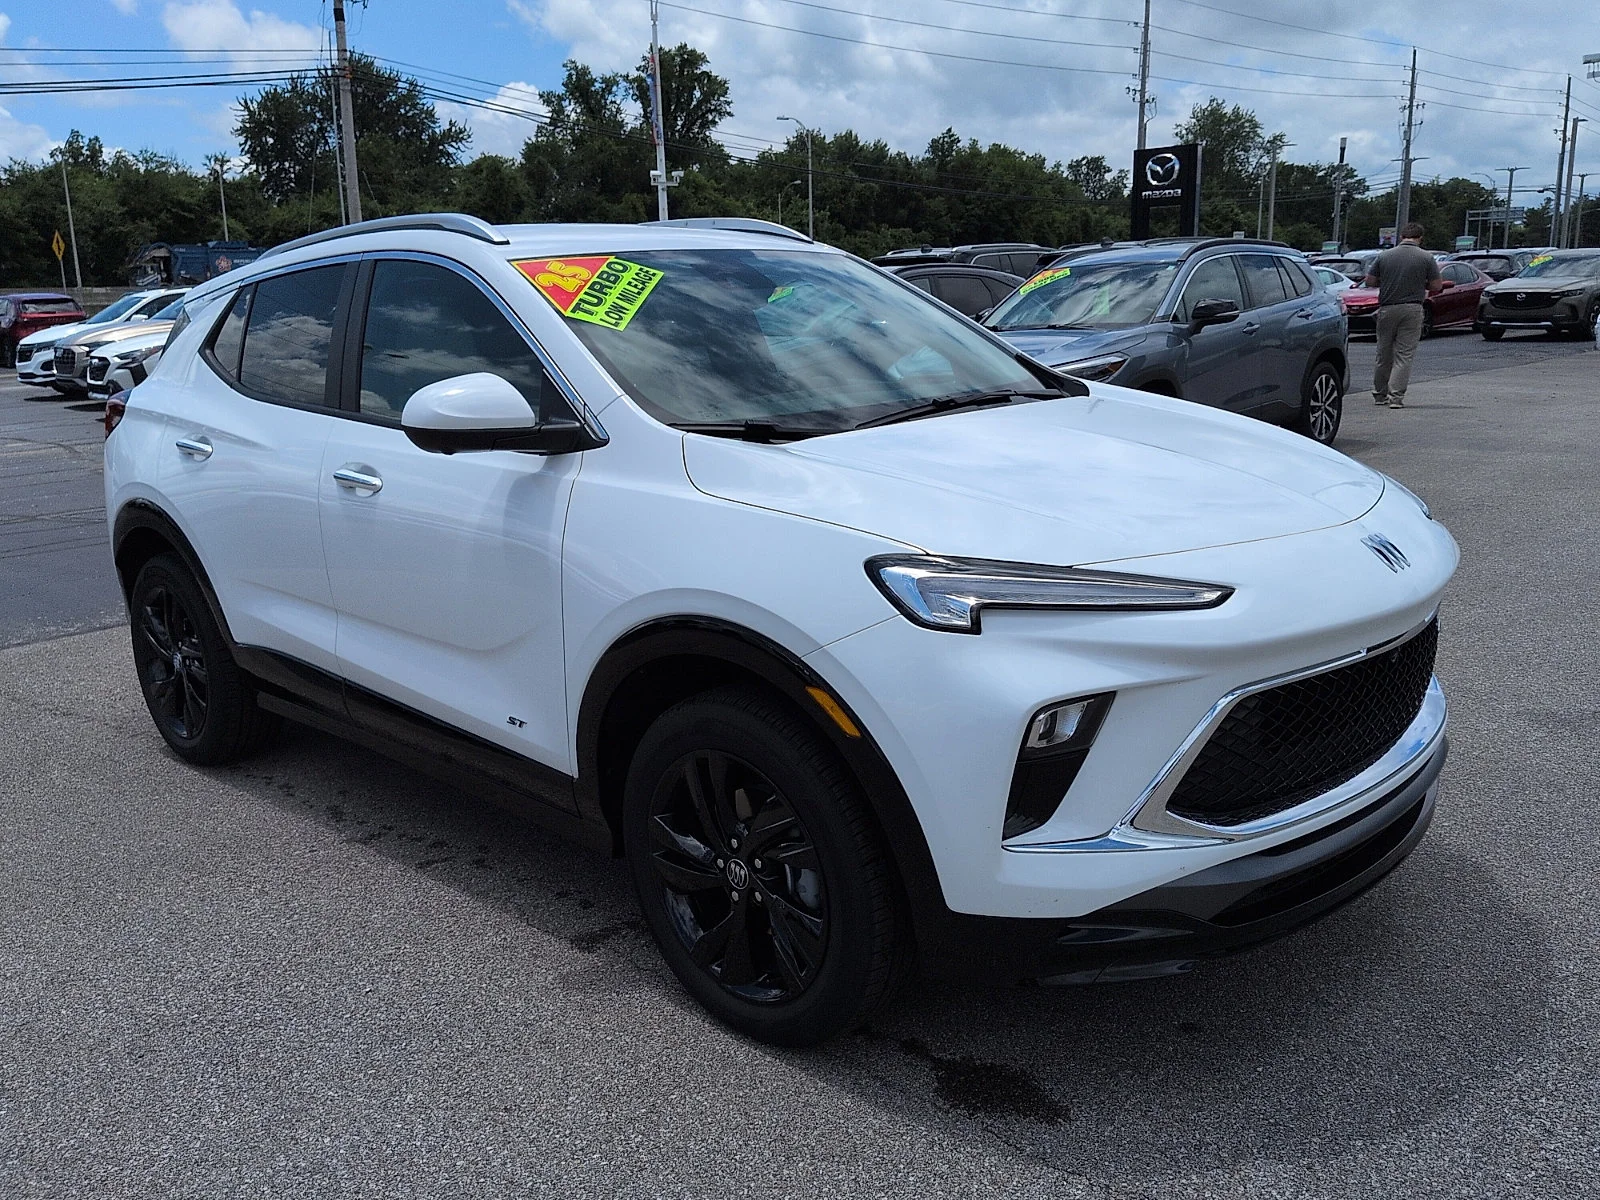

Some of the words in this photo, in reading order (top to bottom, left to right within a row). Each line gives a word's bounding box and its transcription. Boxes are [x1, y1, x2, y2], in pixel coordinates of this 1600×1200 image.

[535, 261, 592, 292] 25
[570, 261, 633, 316] TURBO
[600, 302, 630, 327] LOW
[620, 267, 657, 305] MILEAGE
[506, 716, 528, 728] ST
